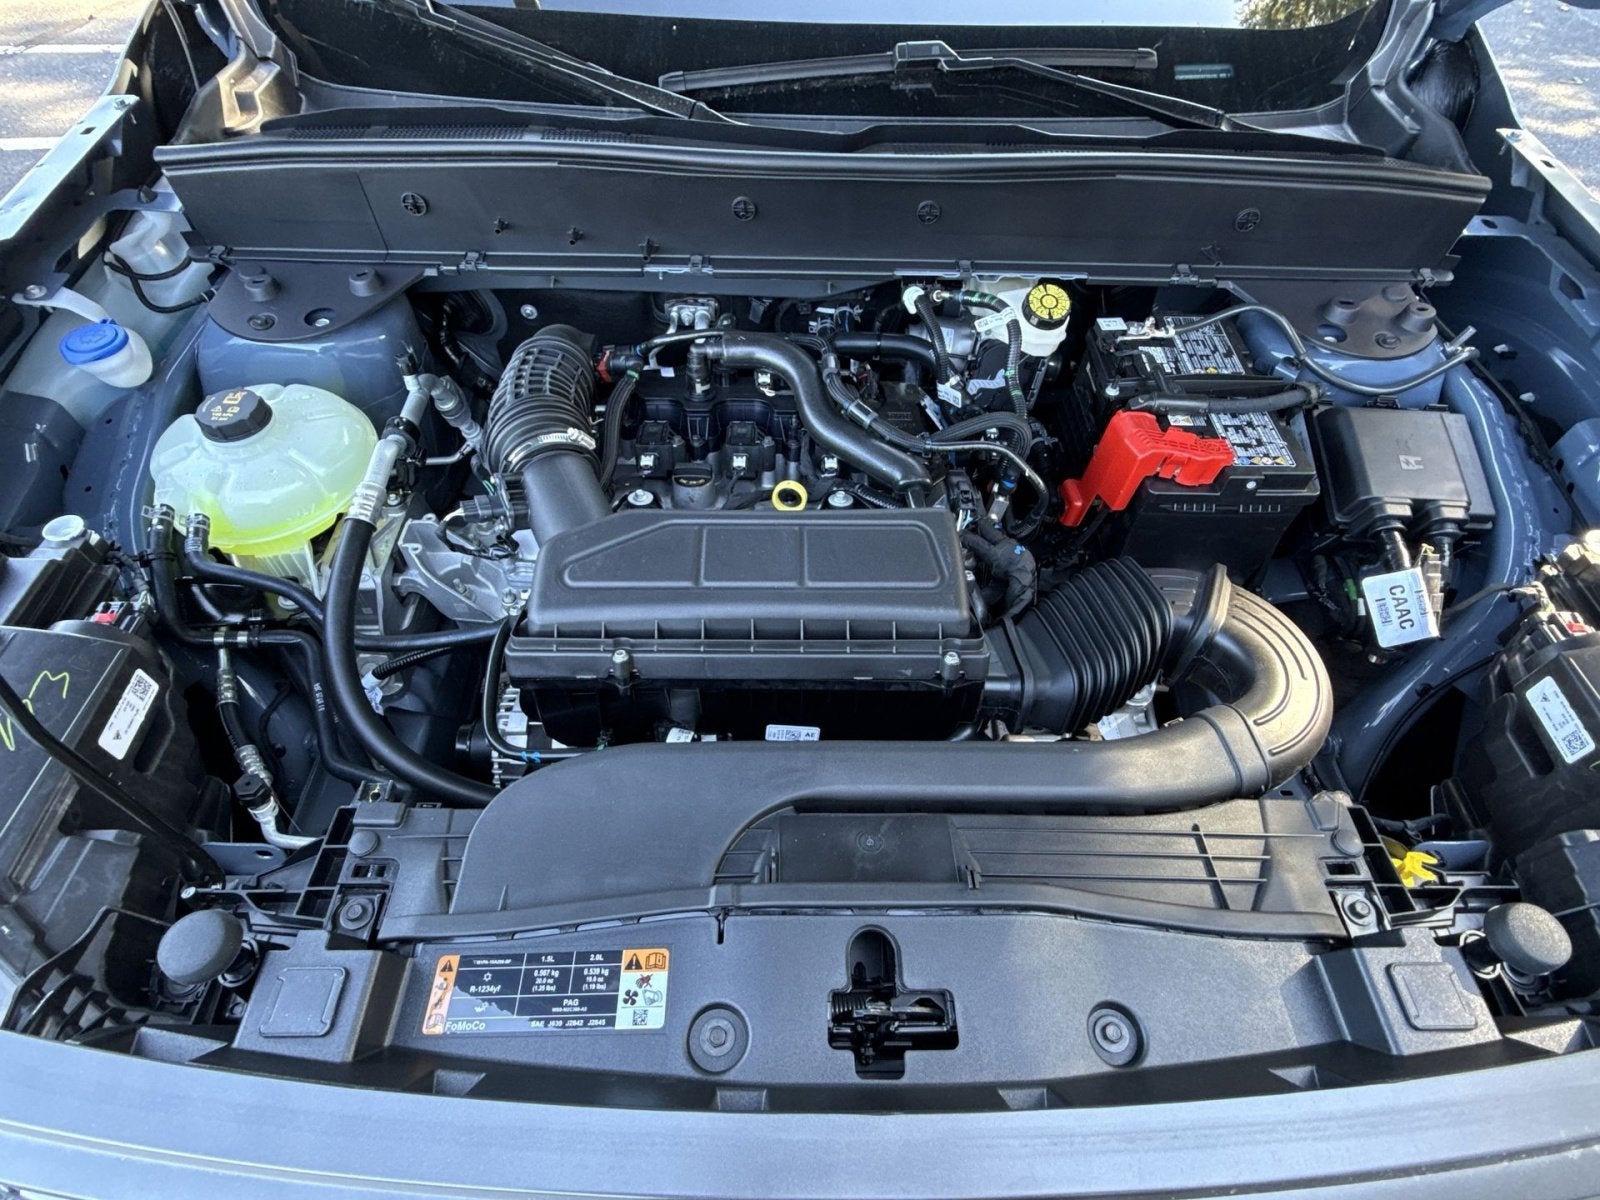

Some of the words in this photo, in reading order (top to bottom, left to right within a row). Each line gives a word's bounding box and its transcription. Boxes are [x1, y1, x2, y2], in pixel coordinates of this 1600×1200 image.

[1388, 584, 1415, 630] CAAC
[541, 955, 555, 963] 1.5L
[589, 953, 604, 961] 2.0L
[551, 969, 560, 978] kg
[600, 967, 610, 977] kg
[469, 984, 502, 994] R-1234yf
[563, 998, 579, 1007] PAG
[445, 1020, 486, 1031] FoMoCo
